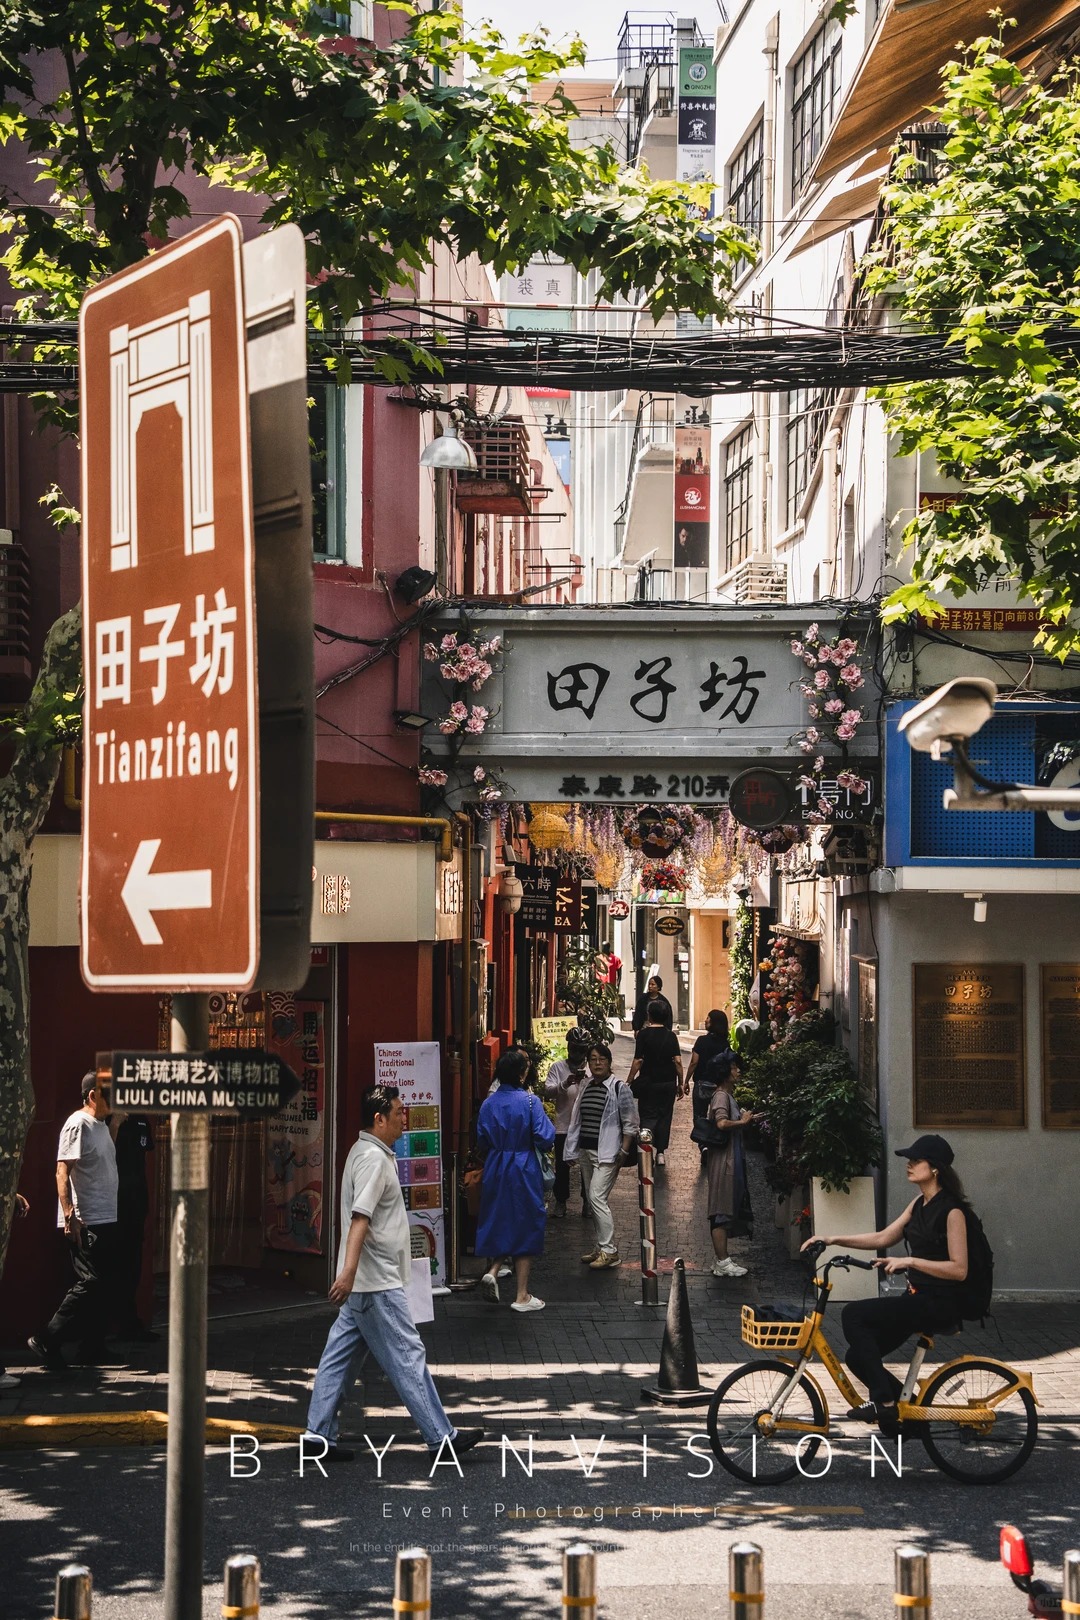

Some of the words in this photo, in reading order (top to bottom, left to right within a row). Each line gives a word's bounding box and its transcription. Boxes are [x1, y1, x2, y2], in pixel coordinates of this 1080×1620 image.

[940, 611, 1050, 622] 田子坊1号门向前80
[96, 588, 237, 709] 田子坊
[547, 656, 767, 724] 田子坊
[96, 721, 238, 791] Tianzifang
[558, 774, 731, 798] 泰康路210弄
[522, 876, 551, 891] 六時
[554, 917, 571, 926] EA
[944, 984, 992, 999] 田子坊
[378, 1049, 402, 1057] Chinese
[379, 1059, 415, 1067] Traditional
[117, 1058, 280, 1085] 上海琉璃艺术博物馆
[379, 1069, 397, 1079] Lucky
[399, 1079, 415, 1087] Lions
[116, 1088, 154, 1105] LIULI
[159, 1088, 207, 1106] CHINA
[212, 1090, 280, 1107] MUSEUM
